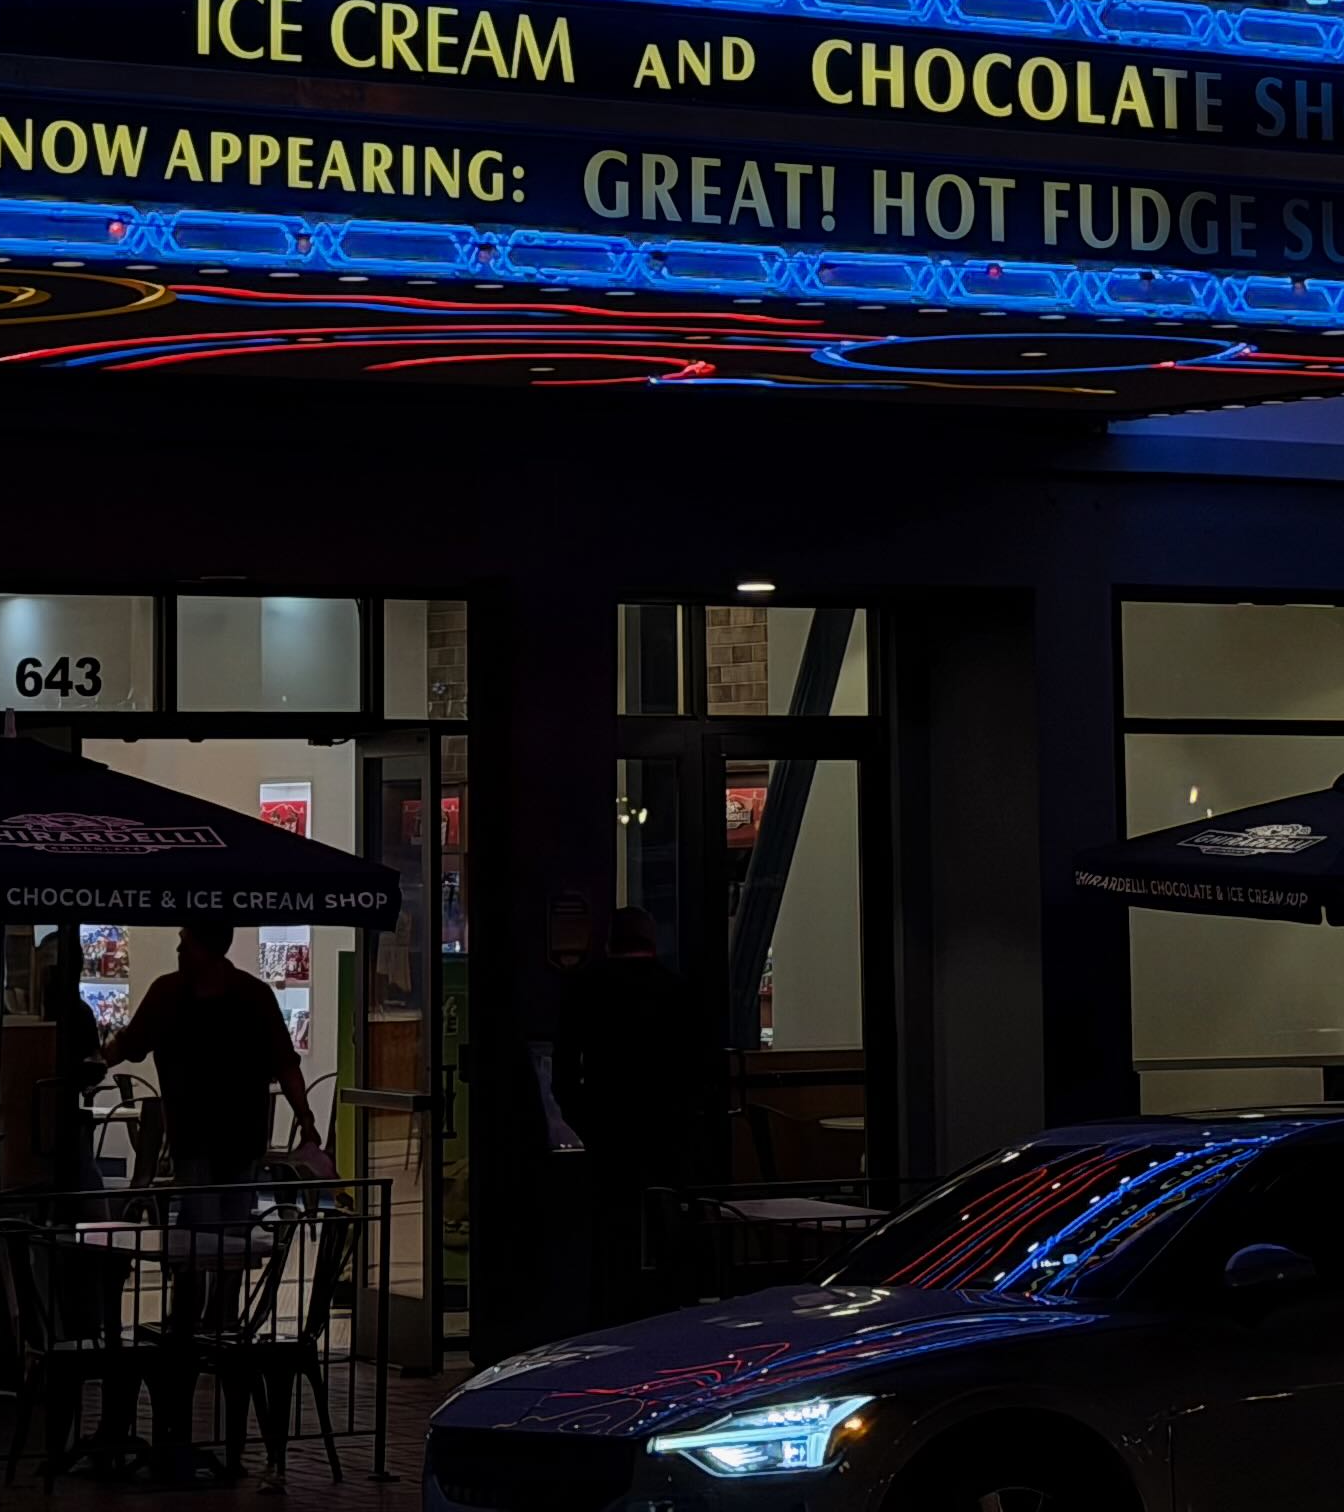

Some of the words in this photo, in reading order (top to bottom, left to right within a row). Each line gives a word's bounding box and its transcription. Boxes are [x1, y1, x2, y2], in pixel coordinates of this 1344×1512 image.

[330, 0, 575, 84] CREAM
[633, 36, 755, 90] AND
[812, 38, 1225, 134] CHOCOLATE
[165, 129, 526, 203] APPEARING:
[584, 150, 835, 231] GREAT!
[873, 169, 1015, 243] HOT
[1044, 181, 1256, 256] FUDGE
[15, 656, 102, 698] 643
[7, 887, 151, 909] CHOCOLATE
[161, 888, 177, 909] &
[185, 888, 224, 909] ICE
[232, 888, 315, 912] CREAM
[324, 890, 389, 911] SHOP
[1150, 879, 1212, 901] CHOCOLATE
[1227, 885, 1245, 903] ICE
